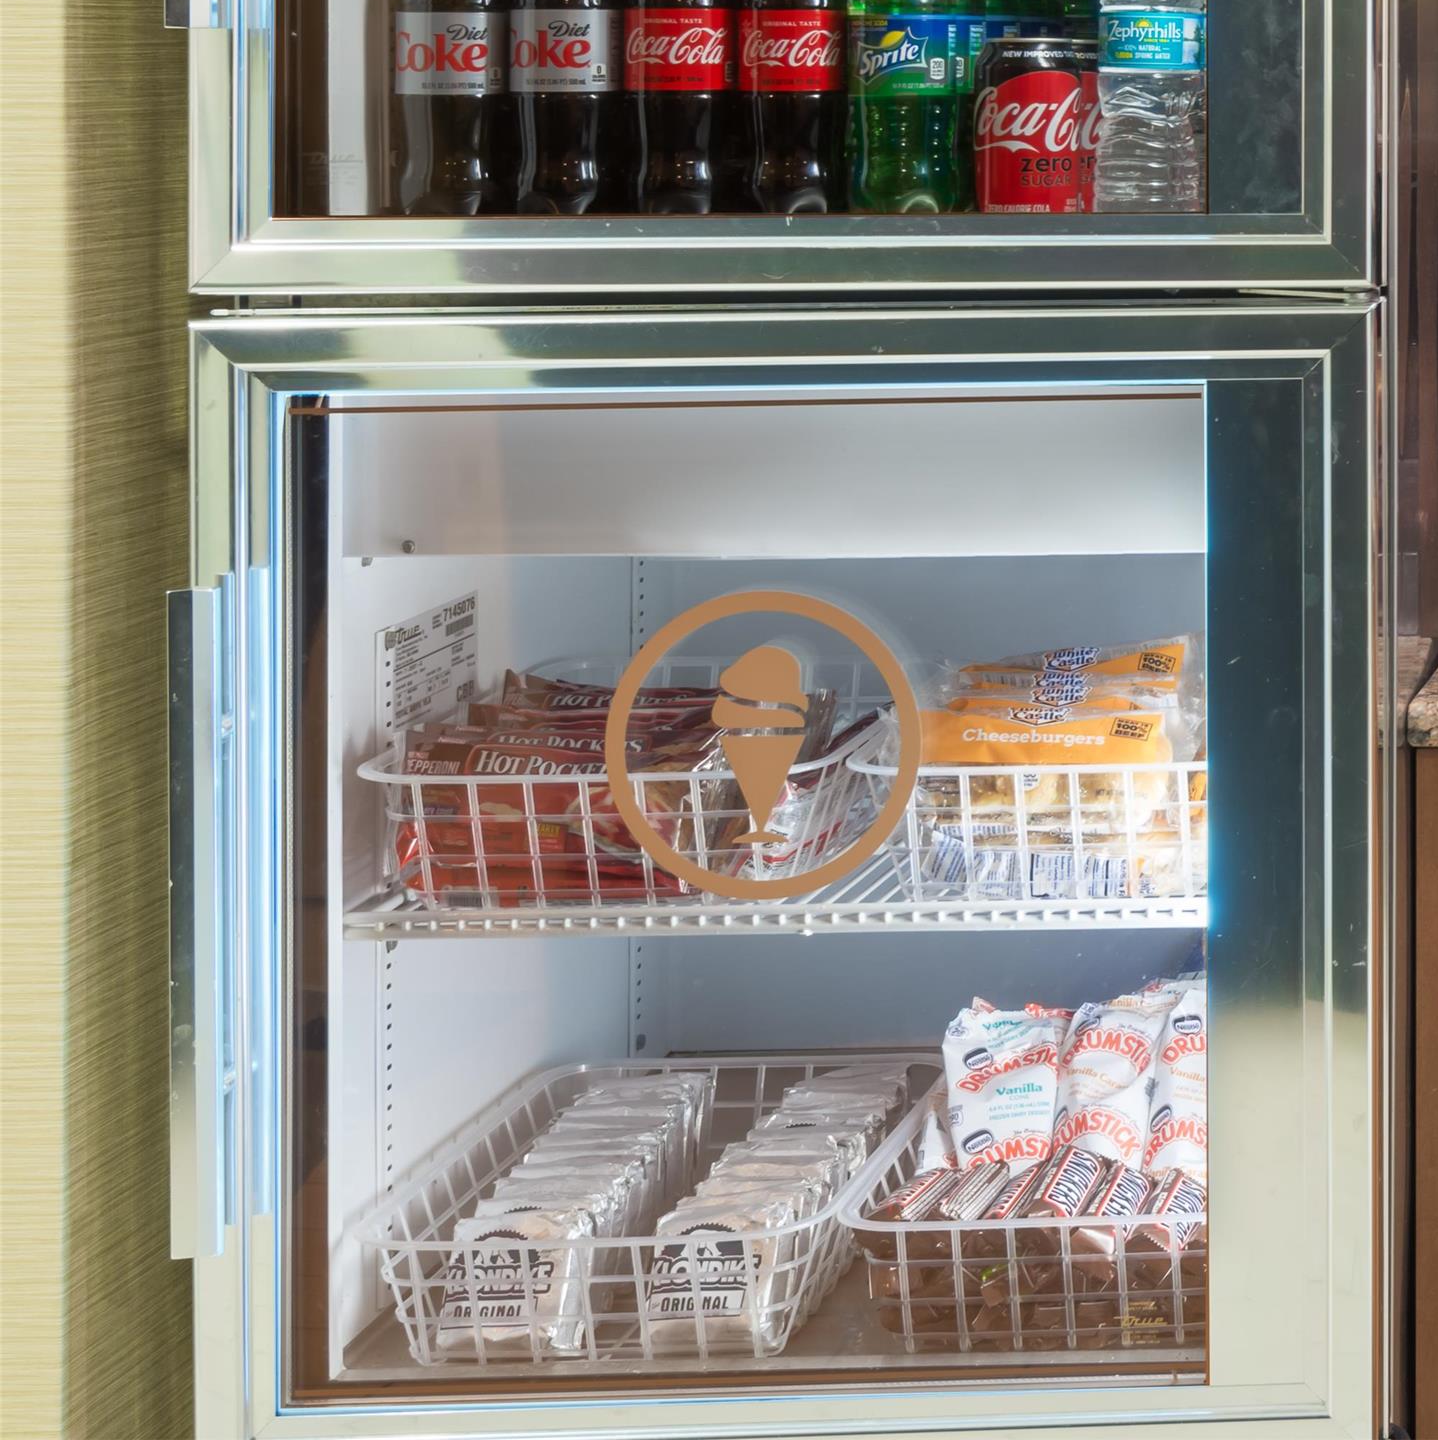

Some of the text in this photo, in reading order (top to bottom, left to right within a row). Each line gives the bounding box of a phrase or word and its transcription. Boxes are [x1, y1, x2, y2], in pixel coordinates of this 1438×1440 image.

[446, 23, 489, 41] Diet
[548, 20, 591, 38] Diet
[1107, 19, 1182, 42] Zephyrhills
[626, 27, 728, 65] Coca-Cola
[743, 29, 841, 68] Coca-Cola
[860, 39, 920, 77] Sprite
[1020, 157, 1072, 173] zero
[1020, 174, 1071, 187] SUGAR
[962, 727, 1105, 747] Cheeseburgers
[475, 750, 523, 774] HOT
[995, 1082, 1043, 1096] Vanilla
